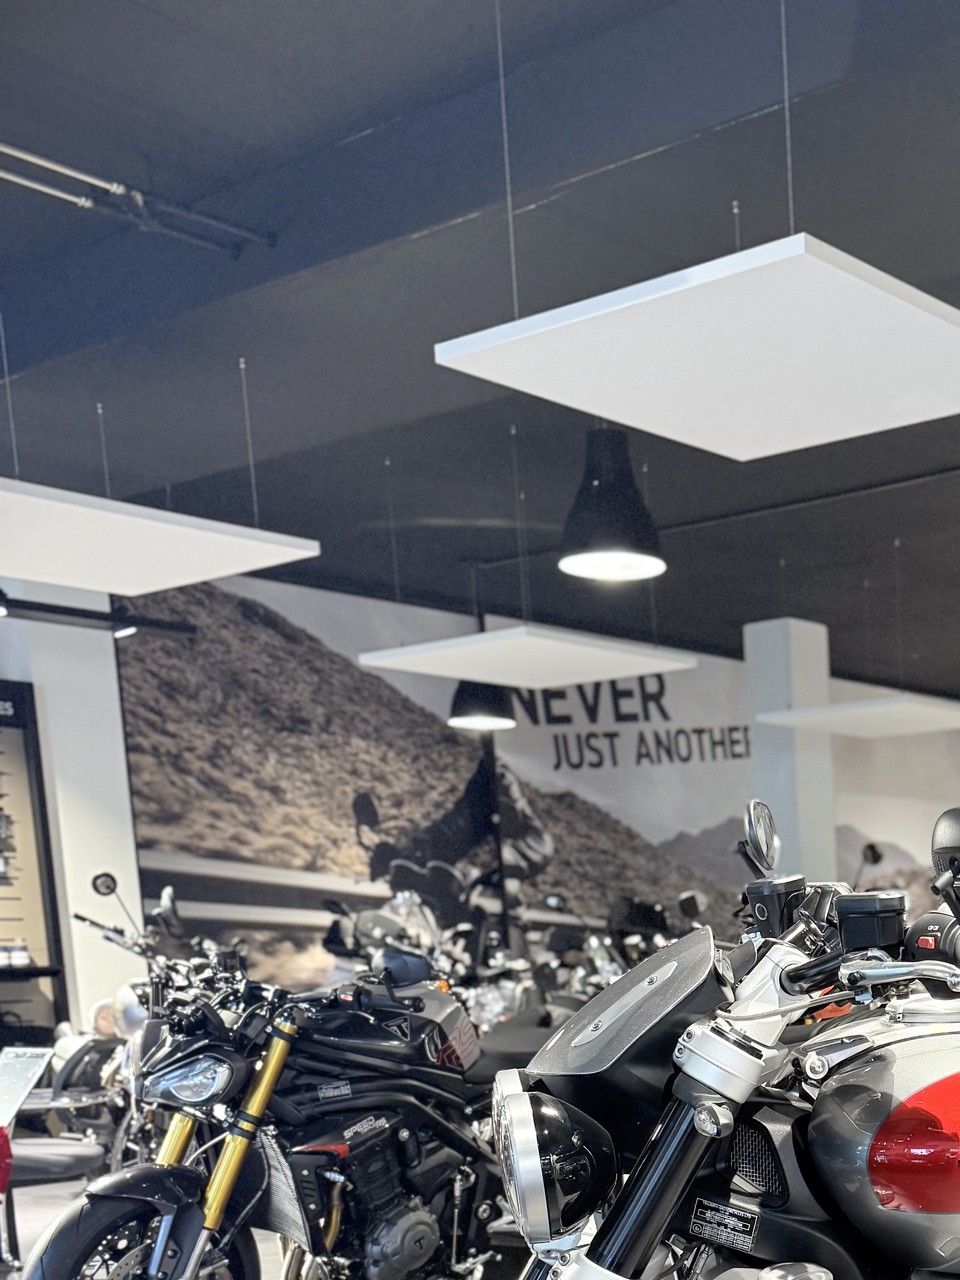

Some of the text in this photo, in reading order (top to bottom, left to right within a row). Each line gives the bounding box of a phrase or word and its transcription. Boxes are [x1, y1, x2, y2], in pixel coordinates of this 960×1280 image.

[512, 673, 671, 726] NEVER
[553, 731, 620, 771] JUST
[343, 1115, 375, 1140] SPEED
